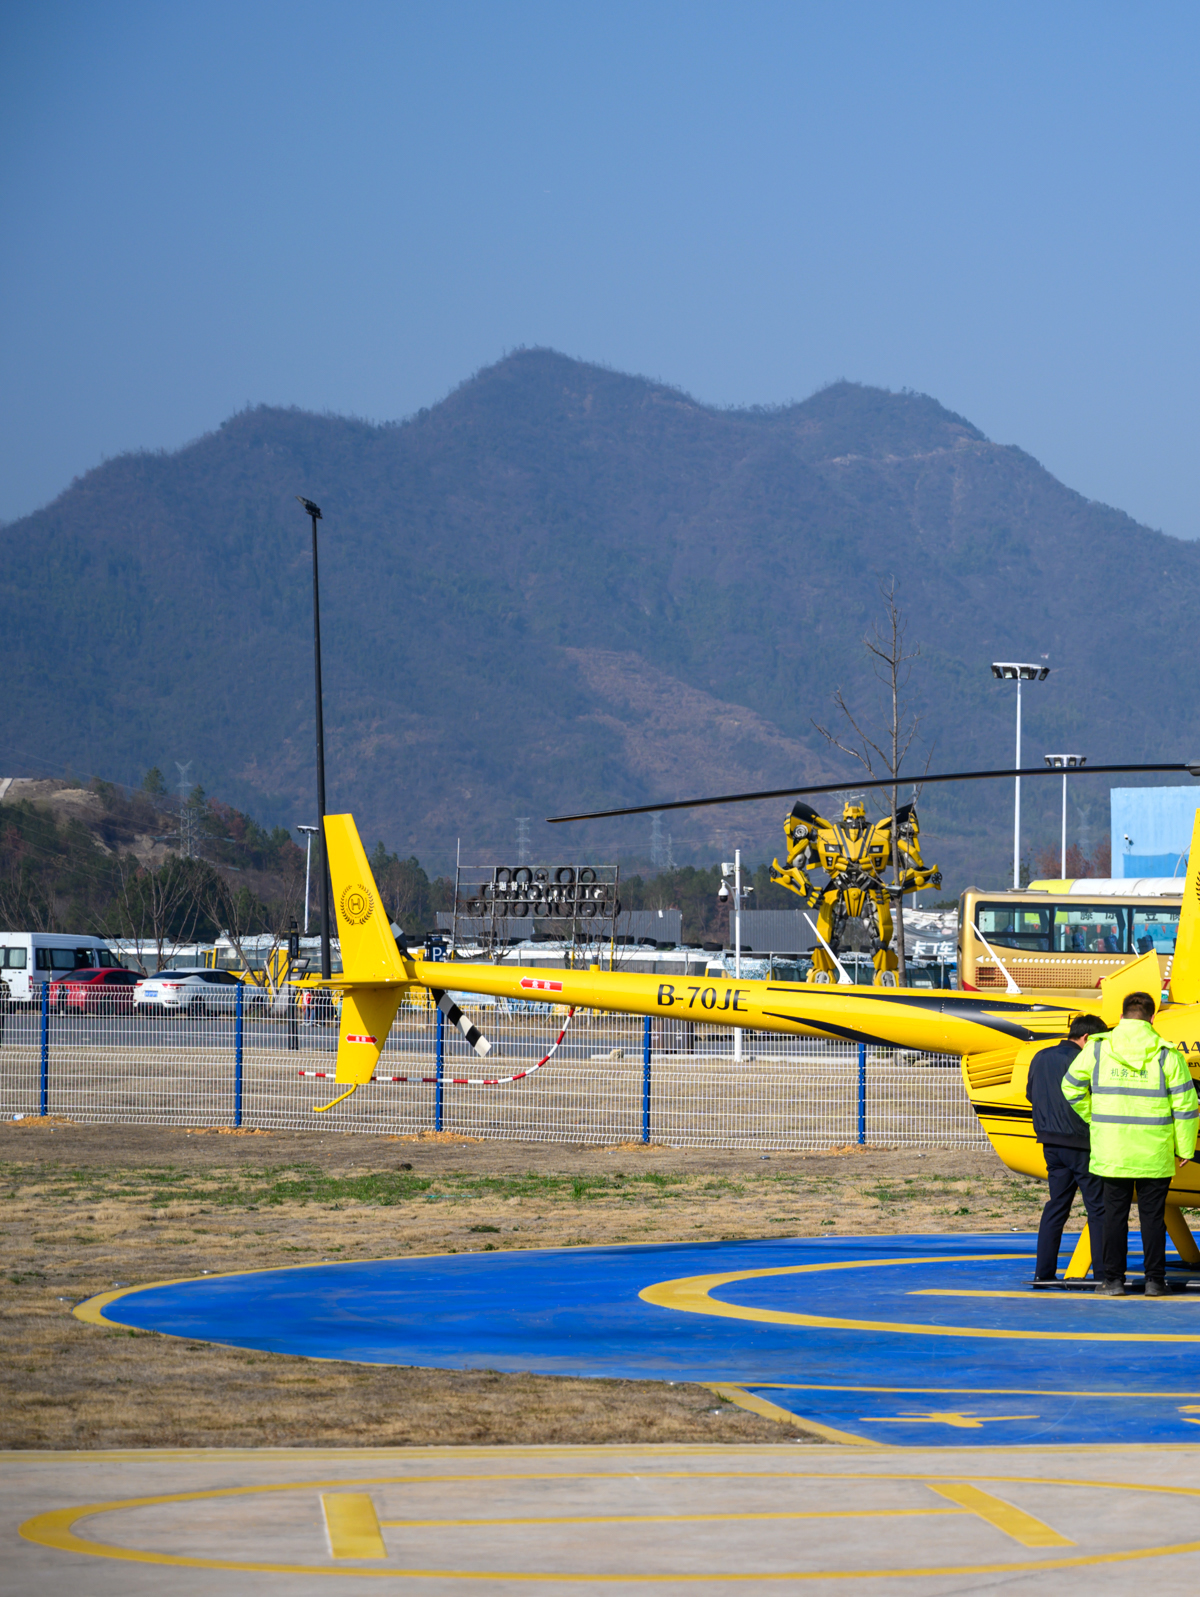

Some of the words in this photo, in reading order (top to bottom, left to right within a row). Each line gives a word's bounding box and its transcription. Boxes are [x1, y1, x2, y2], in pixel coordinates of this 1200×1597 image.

[912, 941, 957, 955] 卡丁车
[657, 983, 751, 1012] B-70JE
[1111, 1068, 1148, 1079] 机务工程
